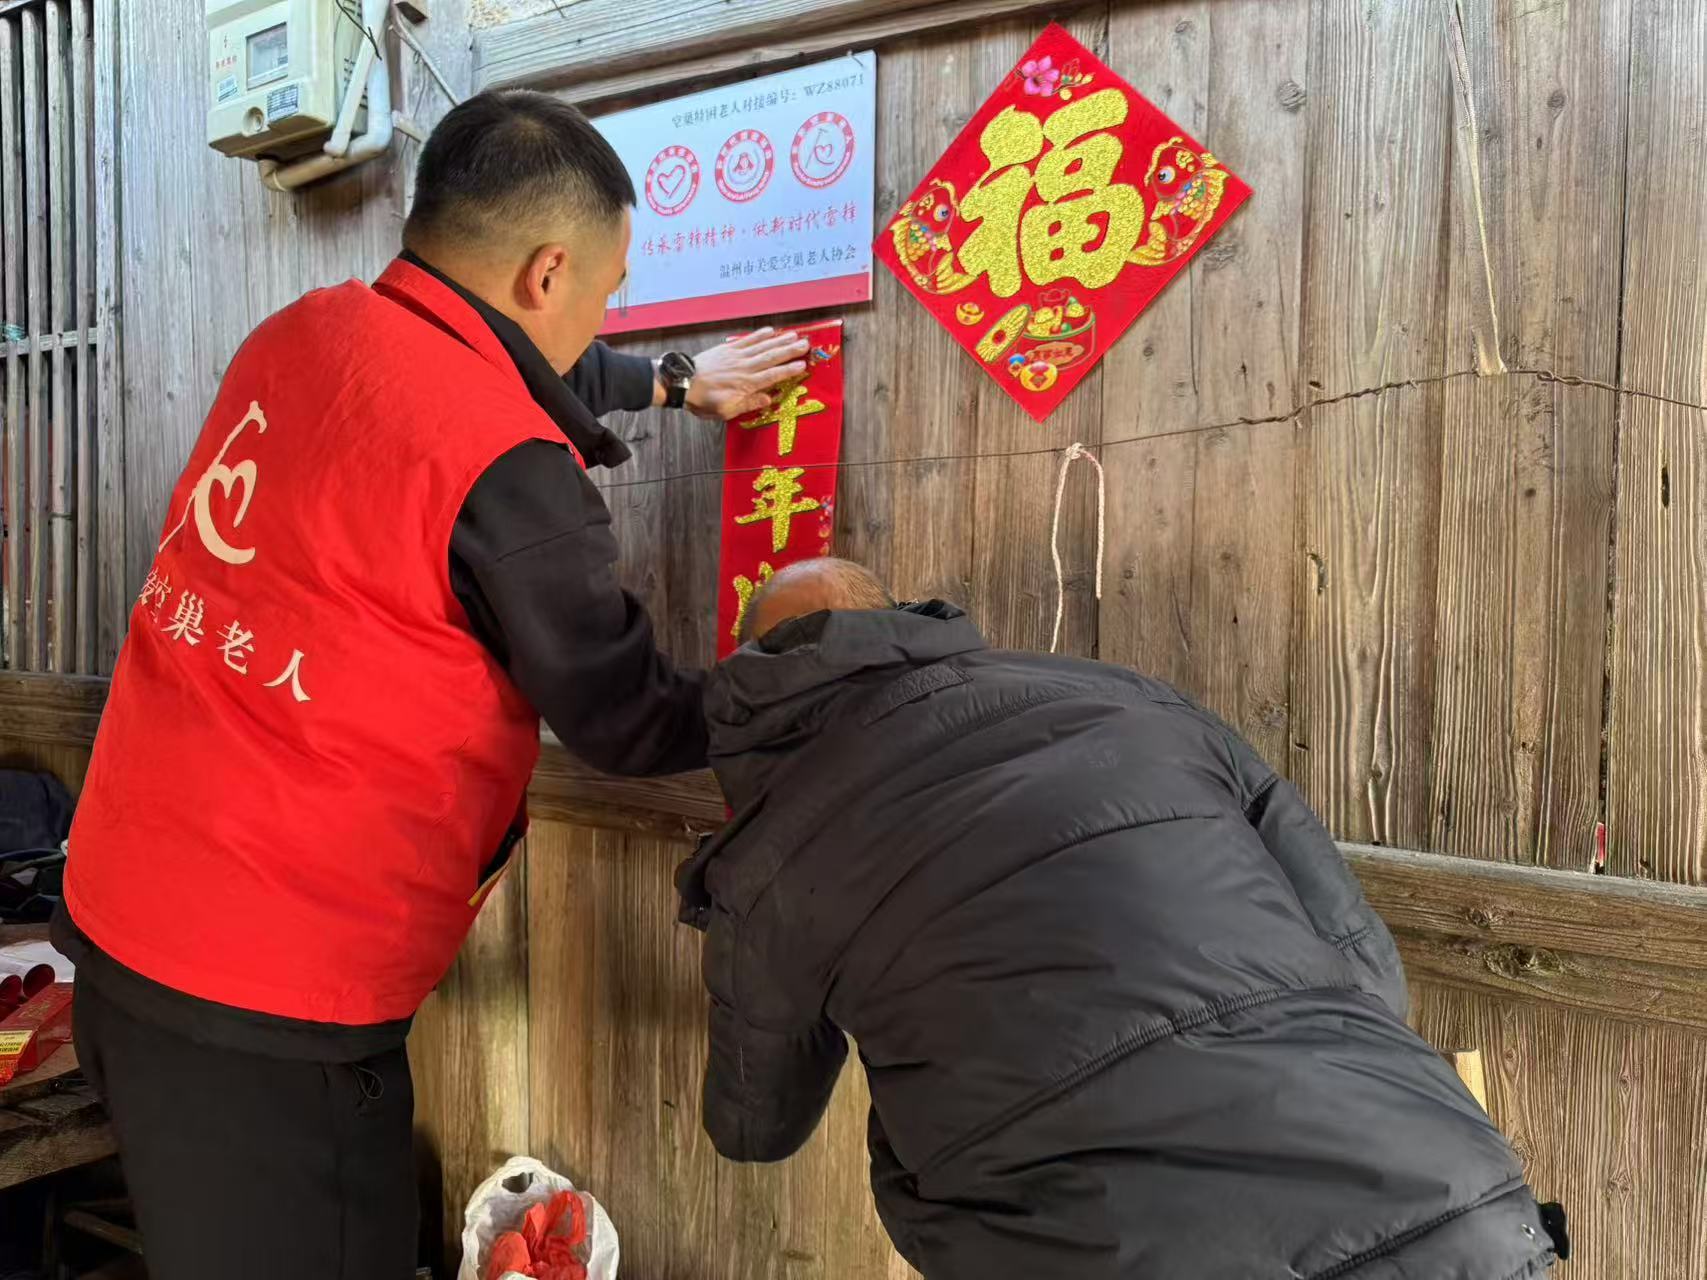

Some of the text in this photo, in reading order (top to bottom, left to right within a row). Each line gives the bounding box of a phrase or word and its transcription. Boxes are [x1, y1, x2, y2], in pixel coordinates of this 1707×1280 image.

[803, 72, 865, 98] WZ88071
[957, 88, 1145, 298] 福
[719, 245, 857, 279] 温州市关爱空巢老人协会
[730, 371, 826, 640] 年年
